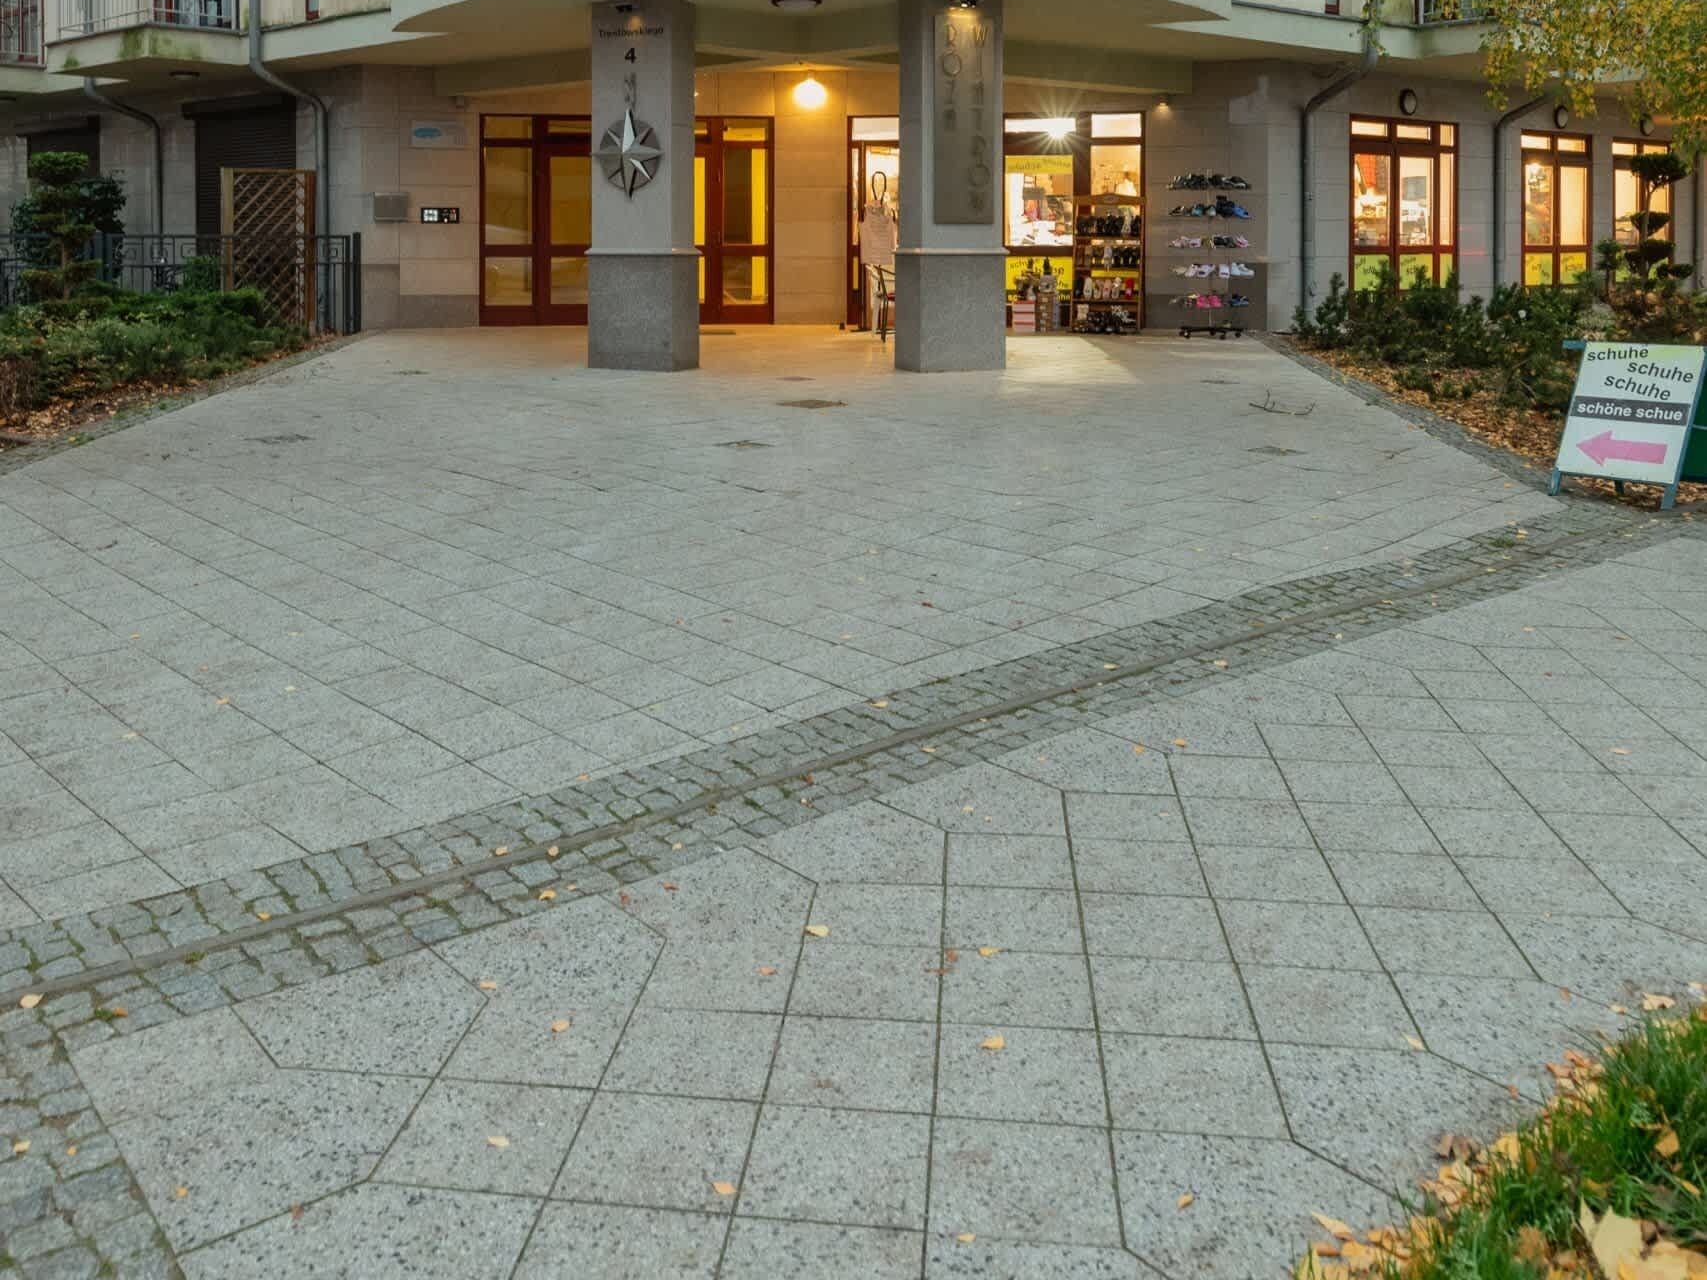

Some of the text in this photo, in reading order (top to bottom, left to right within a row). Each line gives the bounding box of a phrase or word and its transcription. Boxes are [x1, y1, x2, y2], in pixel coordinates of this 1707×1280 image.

[624, 47, 637, 64] 4
[1587, 346, 1649, 362] schuhe
[1627, 361, 1694, 383] schuhe
[1604, 375, 1671, 401] schuhe
[1577, 402, 1632, 417] schöne
